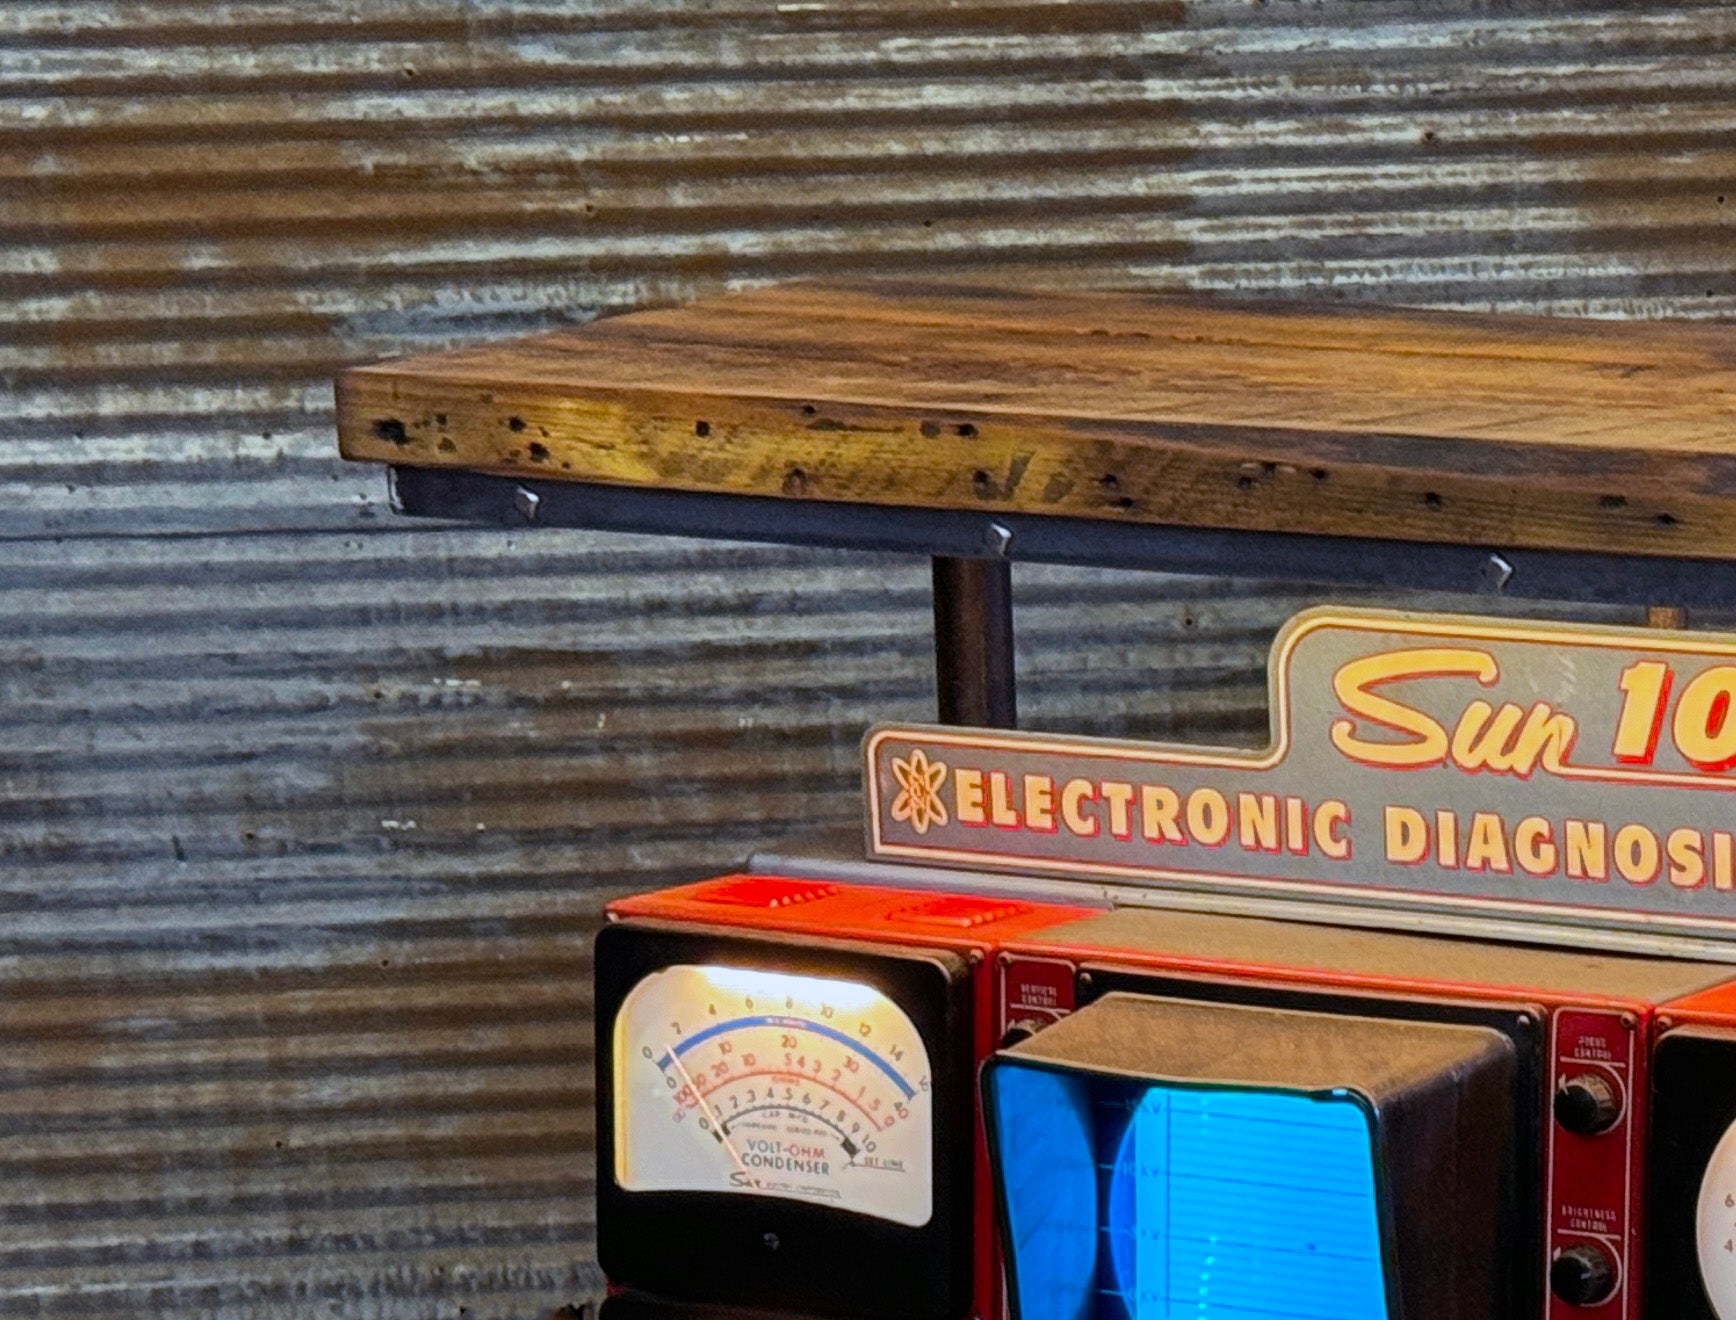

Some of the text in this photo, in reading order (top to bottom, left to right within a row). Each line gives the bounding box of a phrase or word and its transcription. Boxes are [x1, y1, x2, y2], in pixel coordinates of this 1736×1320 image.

[1331, 647, 1578, 781] Sun
[954, 767, 1352, 861] ELECTRONIC
[741, 1152, 831, 1176] CONDENSER
[1724, 1193, 1735, 1208] 6
[1561, 1204, 1617, 1222] BRIGHTNESS
[1724, 1239, 1734, 1252] 4
